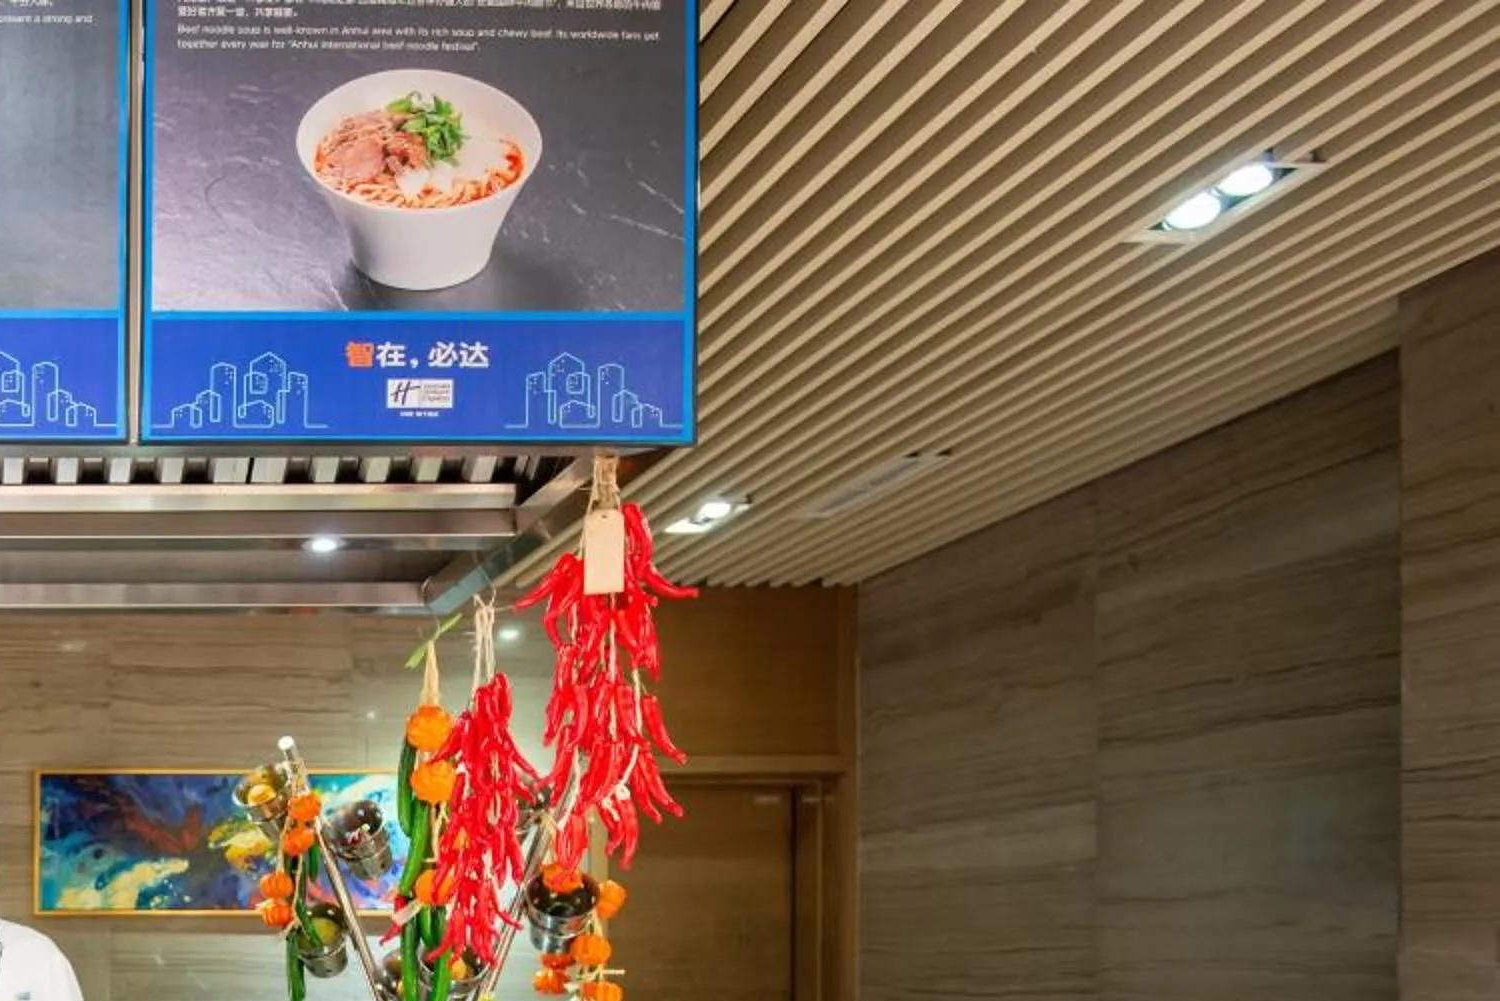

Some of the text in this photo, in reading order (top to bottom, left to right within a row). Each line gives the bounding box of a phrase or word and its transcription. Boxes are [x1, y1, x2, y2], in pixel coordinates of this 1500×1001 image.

[75, 14, 93, 23] and
[177, 24, 200, 33] Beef
[202, 24, 235, 34] noodle
[395, 28, 416, 36] with
[431, 28, 449, 37] rich
[452, 31, 475, 39] soup
[477, 29, 496, 37] and
[498, 29, 528, 40] chewy
[570, 30, 619, 39] worldwide
[177, 39, 218, 50] together
[220, 41, 247, 50] every
